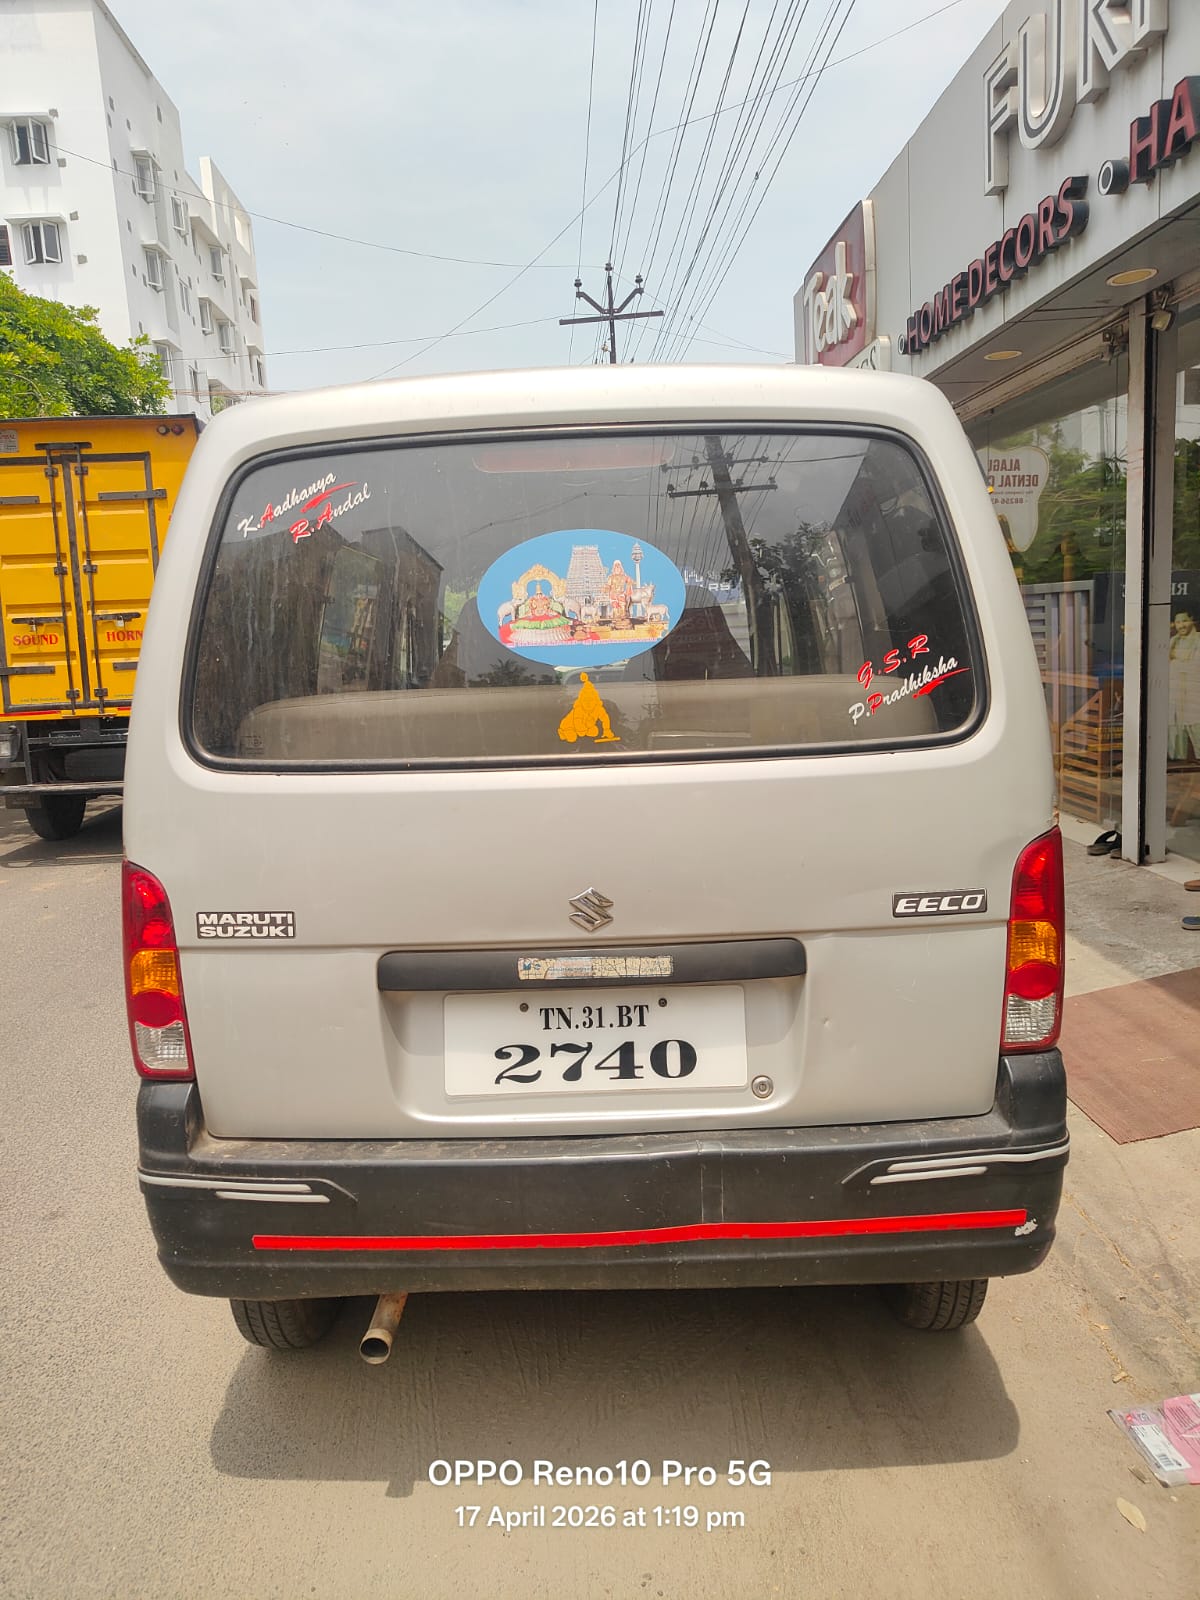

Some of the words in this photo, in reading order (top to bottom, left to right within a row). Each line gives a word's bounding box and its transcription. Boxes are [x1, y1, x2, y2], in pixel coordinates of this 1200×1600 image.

[983, 0, 1167, 196] FUR
[968, 176, 1090, 308] DECORS
[804, 241, 858, 365] Teak
[13, 633, 59, 646] SOUND
[106, 629, 144, 642] HORN
[895, 894, 985, 914] EECO
[198, 913, 293, 925] MARUTI
[199, 925, 294, 937] SUZUKI
[539, 1004, 650, 1031] TN.31.BT
[494, 1038, 698, 1086] 2740
